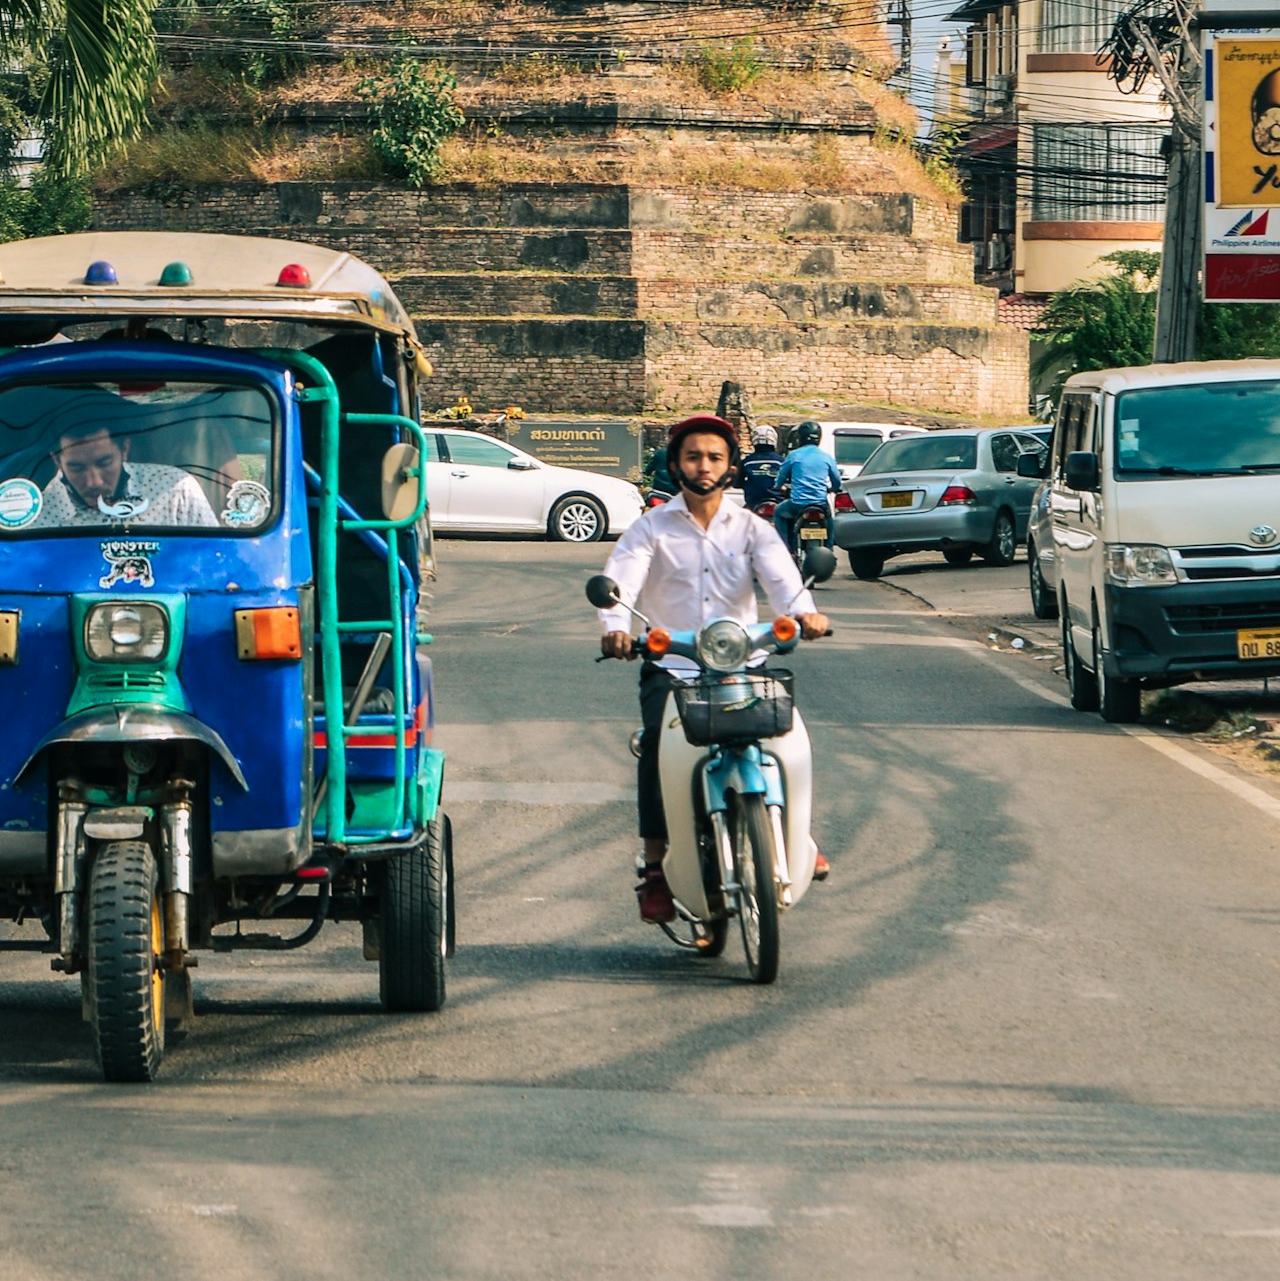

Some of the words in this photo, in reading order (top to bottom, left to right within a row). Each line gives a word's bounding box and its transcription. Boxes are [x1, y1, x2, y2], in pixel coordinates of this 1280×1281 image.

[1211, 239, 1250, 248] Philippine
[1252, 239, 1280, 247] Airlines
[100, 541, 160, 553] MONSTER
